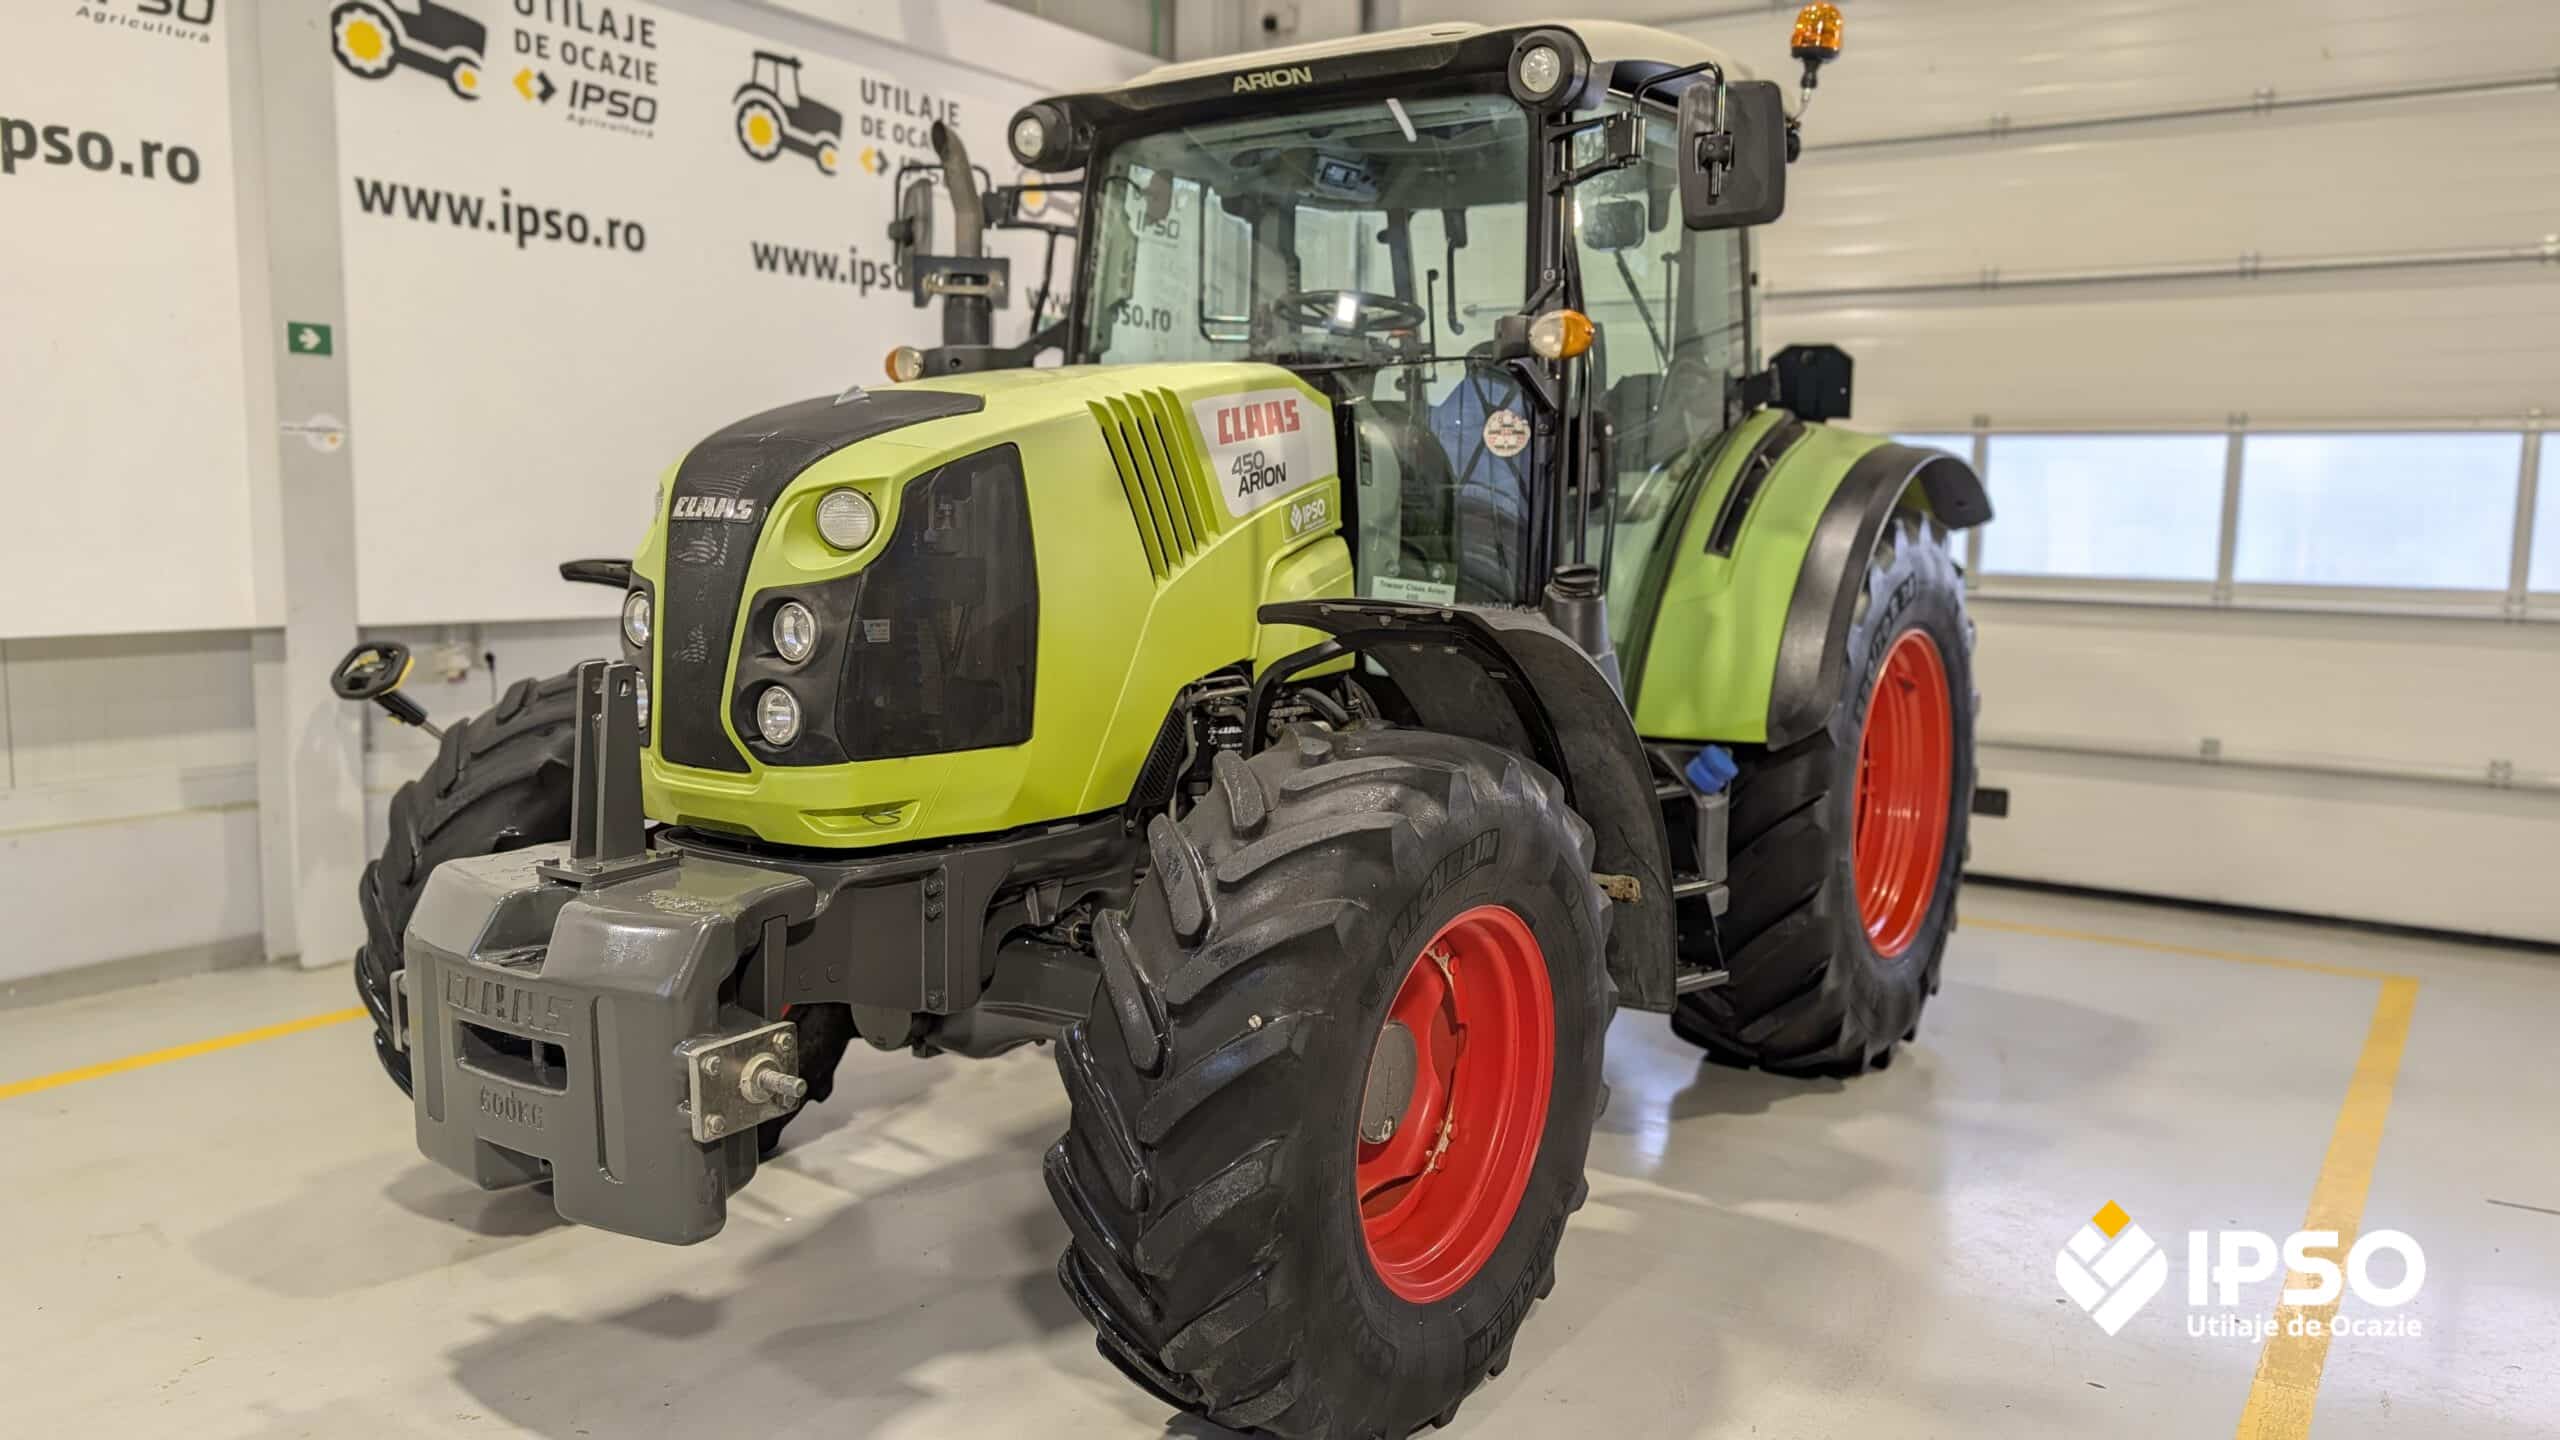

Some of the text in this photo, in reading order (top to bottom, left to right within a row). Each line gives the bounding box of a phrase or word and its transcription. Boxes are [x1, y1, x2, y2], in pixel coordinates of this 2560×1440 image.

[514, 28, 658, 85] DE OCAZIE
[1232, 66, 1313, 93] ARION
[569, 79, 658, 125] IPSO
[861, 114, 886, 140] DE
[354, 175, 646, 253] www.ipso.ro
[1217, 399, 1301, 445] CLAAS
[1231, 449, 1265, 476] 450
[1238, 462, 1287, 498] ARION
[672, 496, 753, 521] CLAAS
[1302, 498, 1326, 524] IPSO
